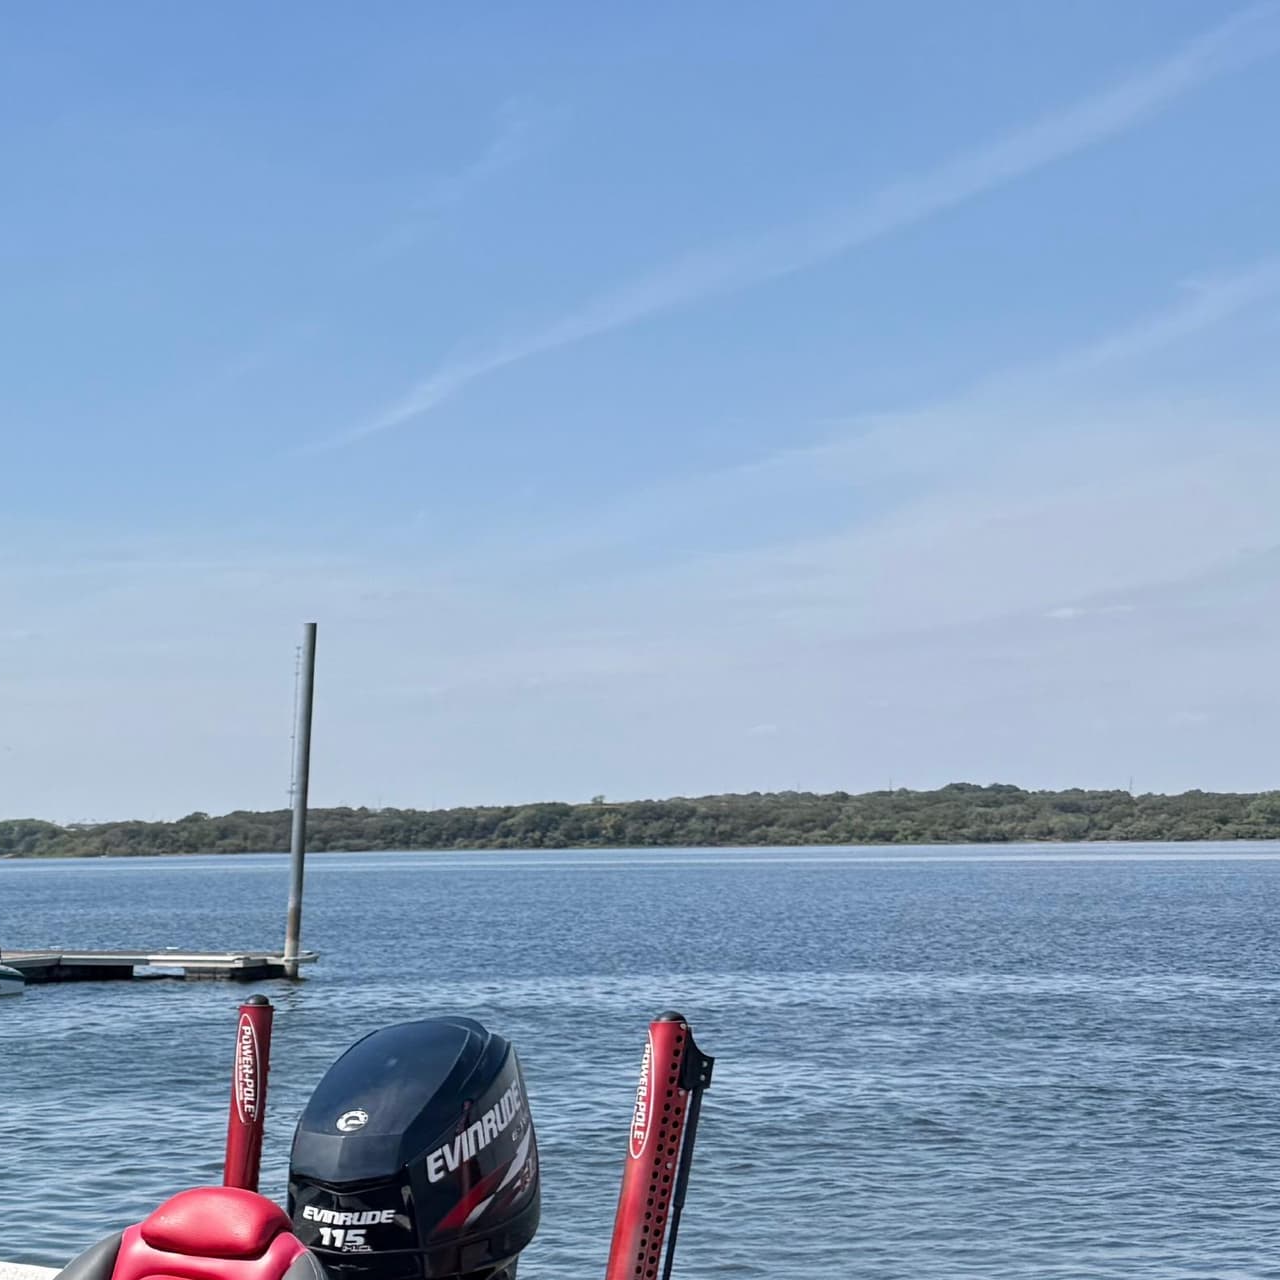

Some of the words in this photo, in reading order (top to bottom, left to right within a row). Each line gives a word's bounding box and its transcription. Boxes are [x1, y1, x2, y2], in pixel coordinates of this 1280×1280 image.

[242, 1025, 257, 1113] POWER-POLE
[426, 1079, 521, 1184] EVINRUDE
[302, 1205, 396, 1226] EVINRUDE
[319, 1227, 367, 1248] 115
